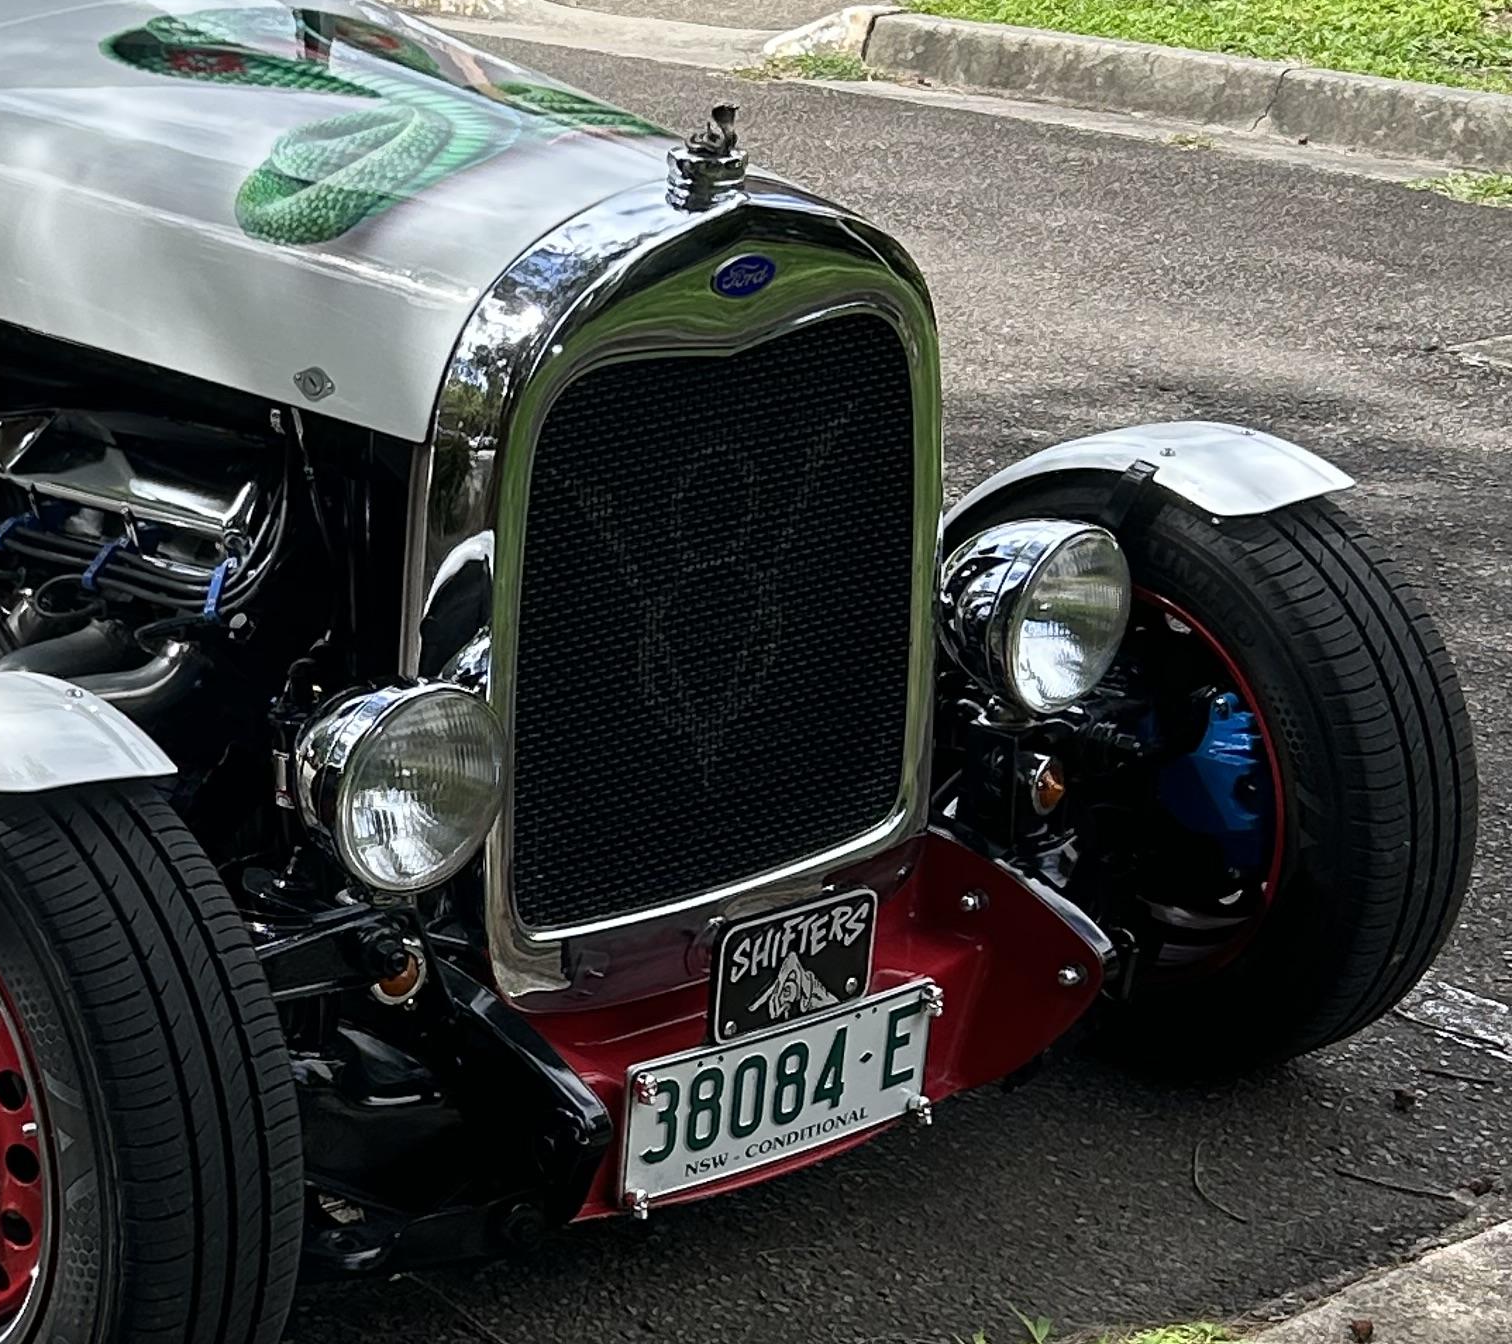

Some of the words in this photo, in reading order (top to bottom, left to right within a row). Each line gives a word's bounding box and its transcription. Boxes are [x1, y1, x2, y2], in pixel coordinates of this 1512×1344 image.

[722, 263, 769, 289] Ford
[1146, 536, 1257, 648] UMHO
[730, 902, 870, 983] SHIFTERS
[684, 1151, 729, 1178] NSW
[745, 1107, 869, 1159] CONDITIONAL
